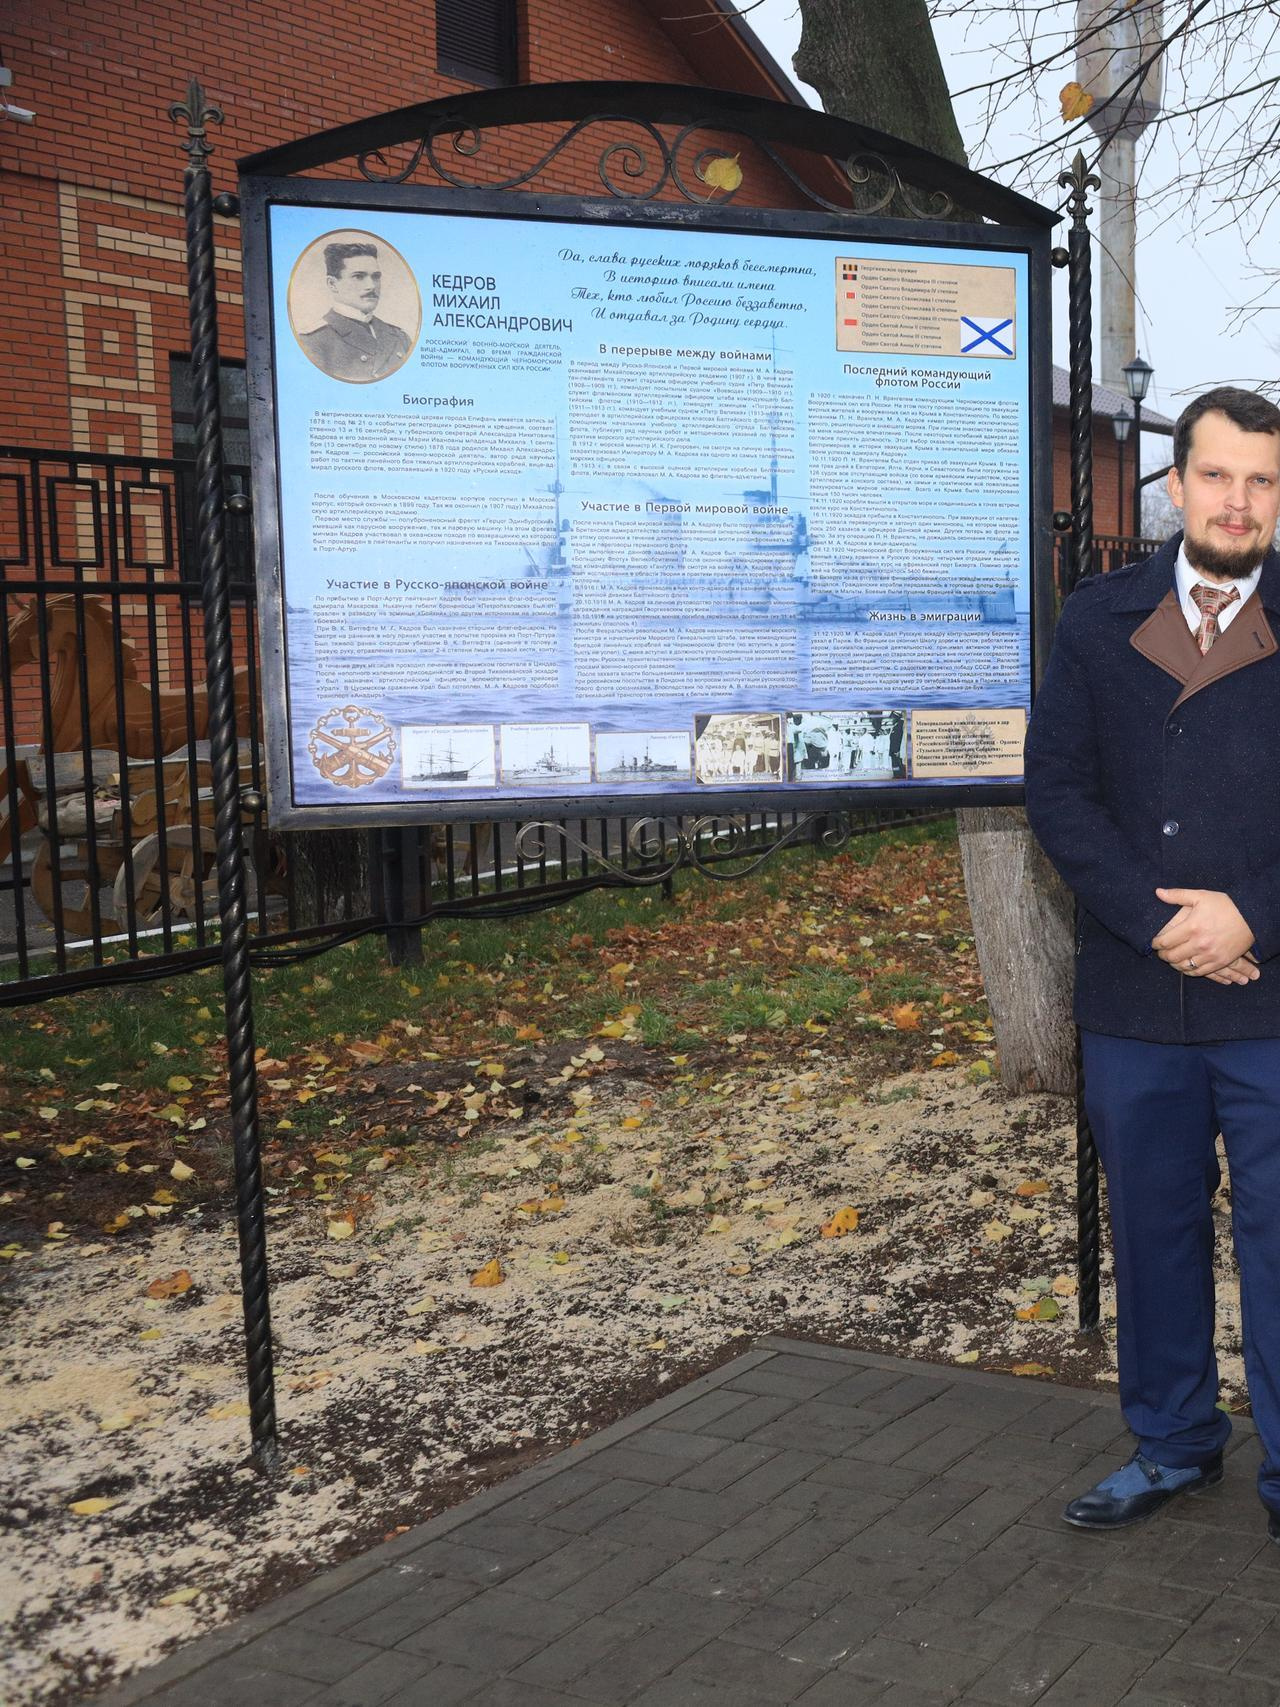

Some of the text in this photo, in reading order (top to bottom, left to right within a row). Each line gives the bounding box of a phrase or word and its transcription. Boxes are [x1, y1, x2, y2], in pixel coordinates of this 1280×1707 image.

[558, 248, 816, 276] Да, слава русских моряков бессмертна,
[432, 274, 496, 291] КЕДРОВ
[603, 270, 774, 290] В историю вписали имена
[433, 293, 499, 309] МИХАИЛ
[571, 287, 806, 312] Тех, кто любил Россию беззаветно,
[433, 313, 572, 332] АЛЕКСАНДРОВИЧ
[591, 307, 787, 329] И отдавал за Родину сердца.
[599, 343, 772, 360] В перерыве между войнами
[844, 364, 992, 380] Последний командующий
[876, 376, 961, 388] флотом России
[403, 394, 473, 408] Биография
[581, 501, 629, 511] Участие
[645, 502, 690, 514] Первой
[695, 503, 749, 515] мировой
[753, 504, 788, 514] войне
[326, 579, 378, 589] Участие
[395, 578, 505, 593] Русско-японской
[510, 580, 548, 590] войне
[870, 612, 906, 621] Жизнь
[920, 614, 981, 623] эмиграции
